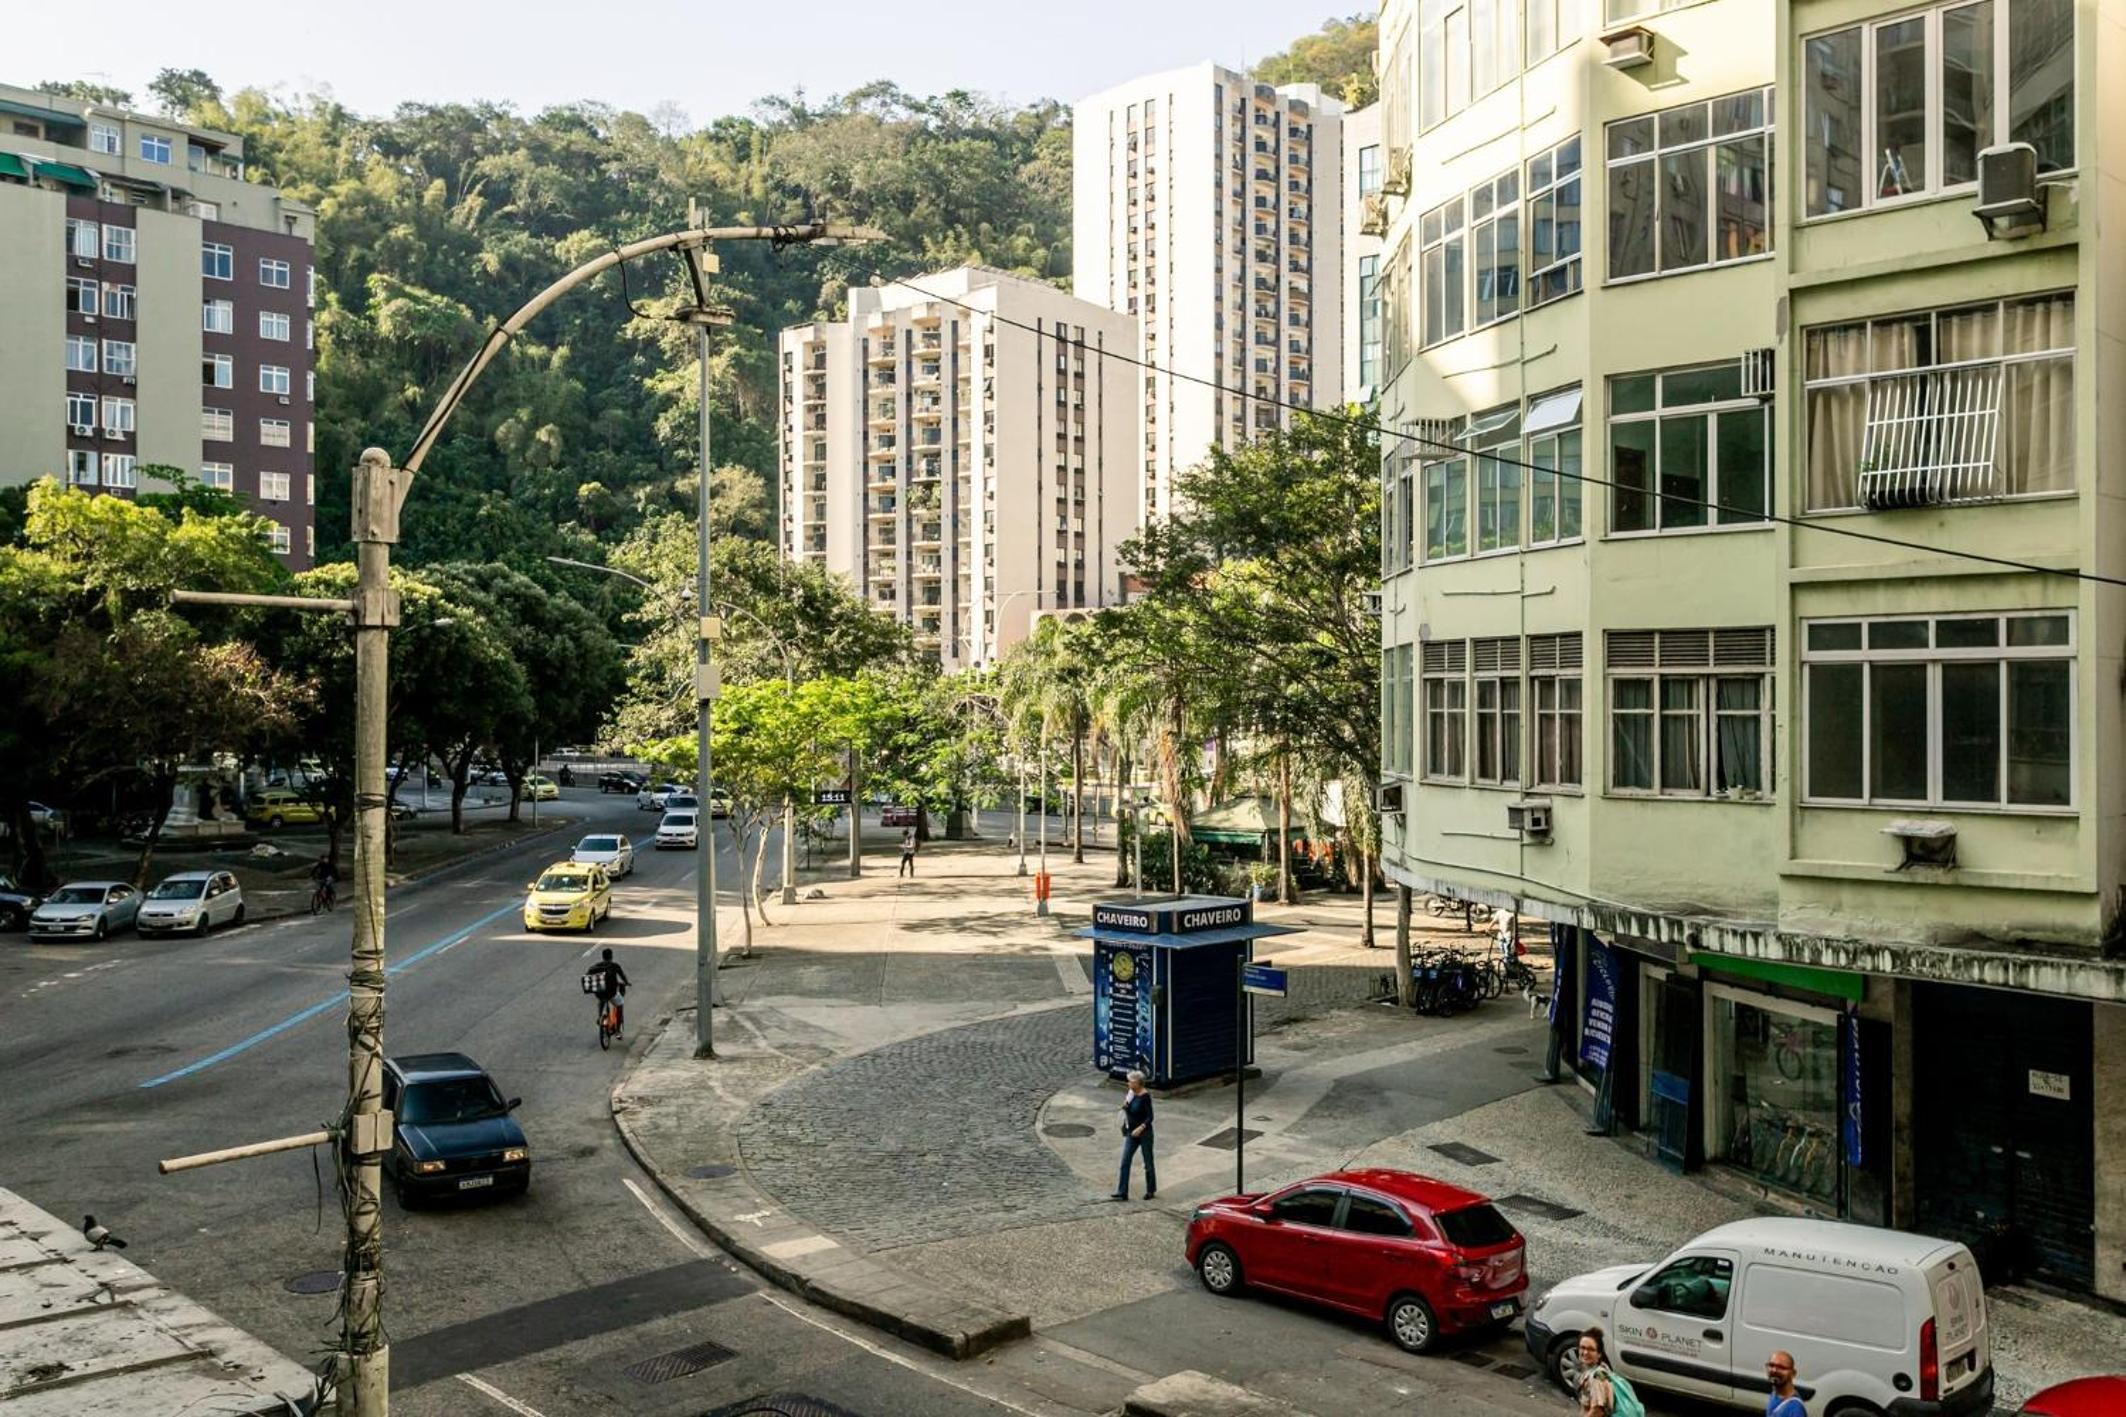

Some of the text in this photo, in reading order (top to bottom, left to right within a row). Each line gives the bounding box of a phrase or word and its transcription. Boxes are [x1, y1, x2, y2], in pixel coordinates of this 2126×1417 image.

[1096, 911, 1148, 929] CHAVEIRO
[1184, 907, 1242, 928] CHAVEIRO
[1618, 1324, 1642, 1337] SKIN
[1661, 1332, 1702, 1349] PLANET
